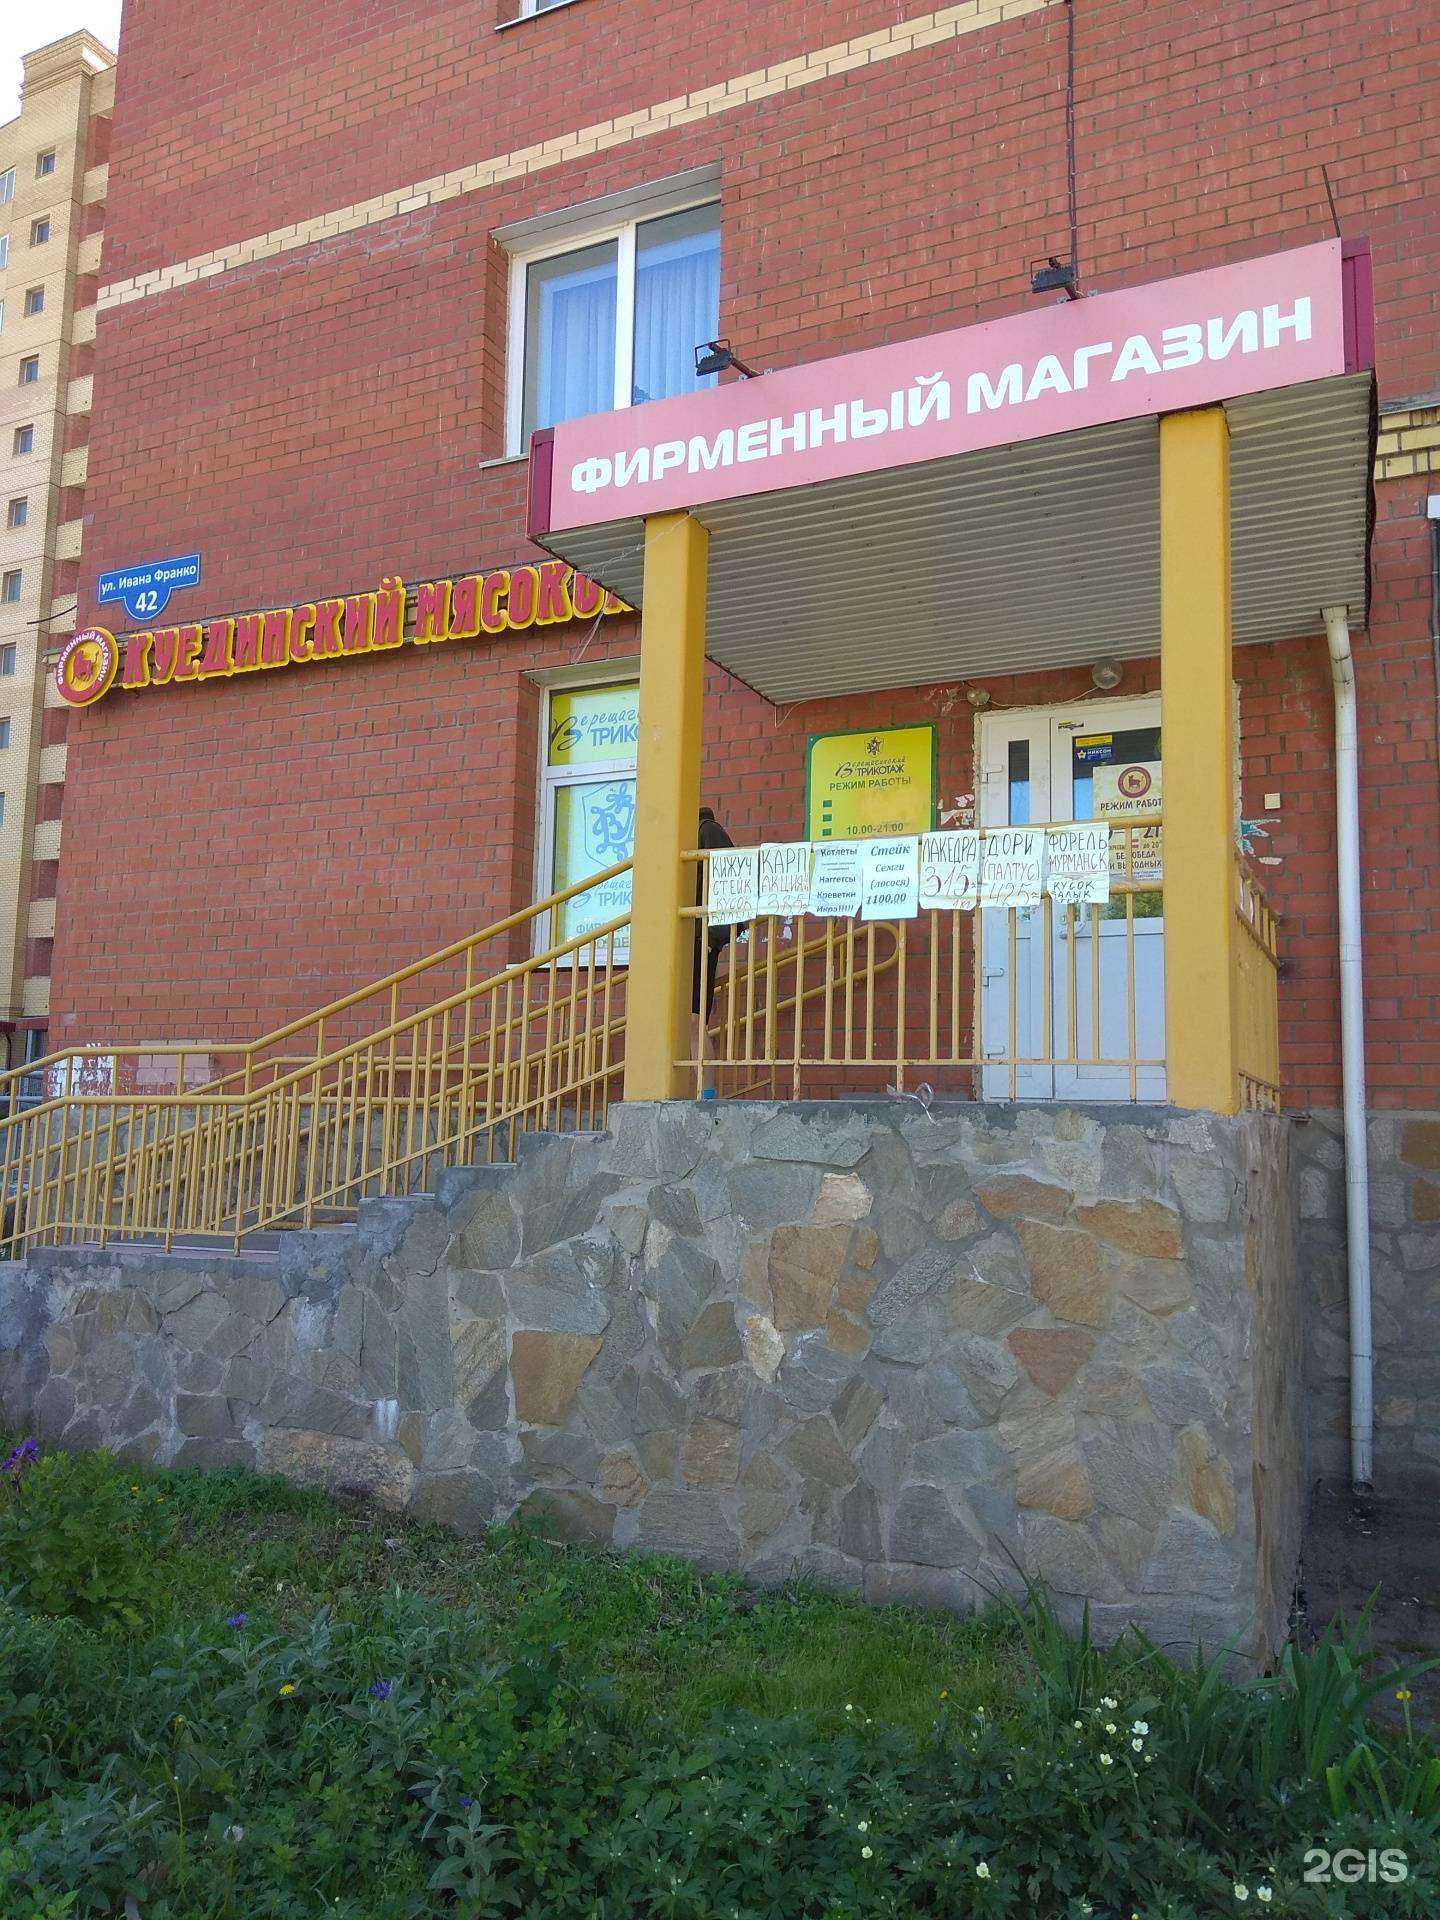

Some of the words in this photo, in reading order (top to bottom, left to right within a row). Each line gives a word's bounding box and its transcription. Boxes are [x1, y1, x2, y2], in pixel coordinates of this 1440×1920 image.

[570, 370, 950, 496] ФИРМЕННЫЙ
[967, 295, 1312, 413] МАГАЗИН
[101, 582, 116, 596] ул.
[118, 573, 152, 589] Ивана
[154, 564, 197, 582] Франко
[135, 590, 158, 612] 42
[121, 575, 406, 689] КУЕДИНСКИЙ
[413, 559, 634, 645] МЯСОКО
[57, 631, 96, 685] ФИРМЕННЫЙ
[95, 634, 110, 682] МАГАЗИН
[590, 722, 638, 747] ТРИК
[856, 763, 905, 777] ТРИКОТАЖ
[829, 779, 866, 792] РЕЖИМ
[868, 776, 911, 789] РАБОТЫ
[1100, 800, 1133, 812] РЕЖИМ
[821, 847, 858, 857] Котлеты
[870, 843, 911, 857] Стейк
[922, 836, 977, 863] ЛАКЕДРА
[987, 833, 1034, 857] ДОРИ
[1049, 831, 1107, 852] ФОРЕЛЬ
[712, 855, 752, 878] КИЖУЧ
[761, 847, 807, 874] КАРП
[983, 859, 1041, 881] (ПАЛТУС)
[1049, 852, 1107, 872] МУРМАНСК
[819, 875, 856, 884] Наггетсы
[1053, 880, 1095, 891] КУСОК
[817, 891, 856, 900] Креветки
